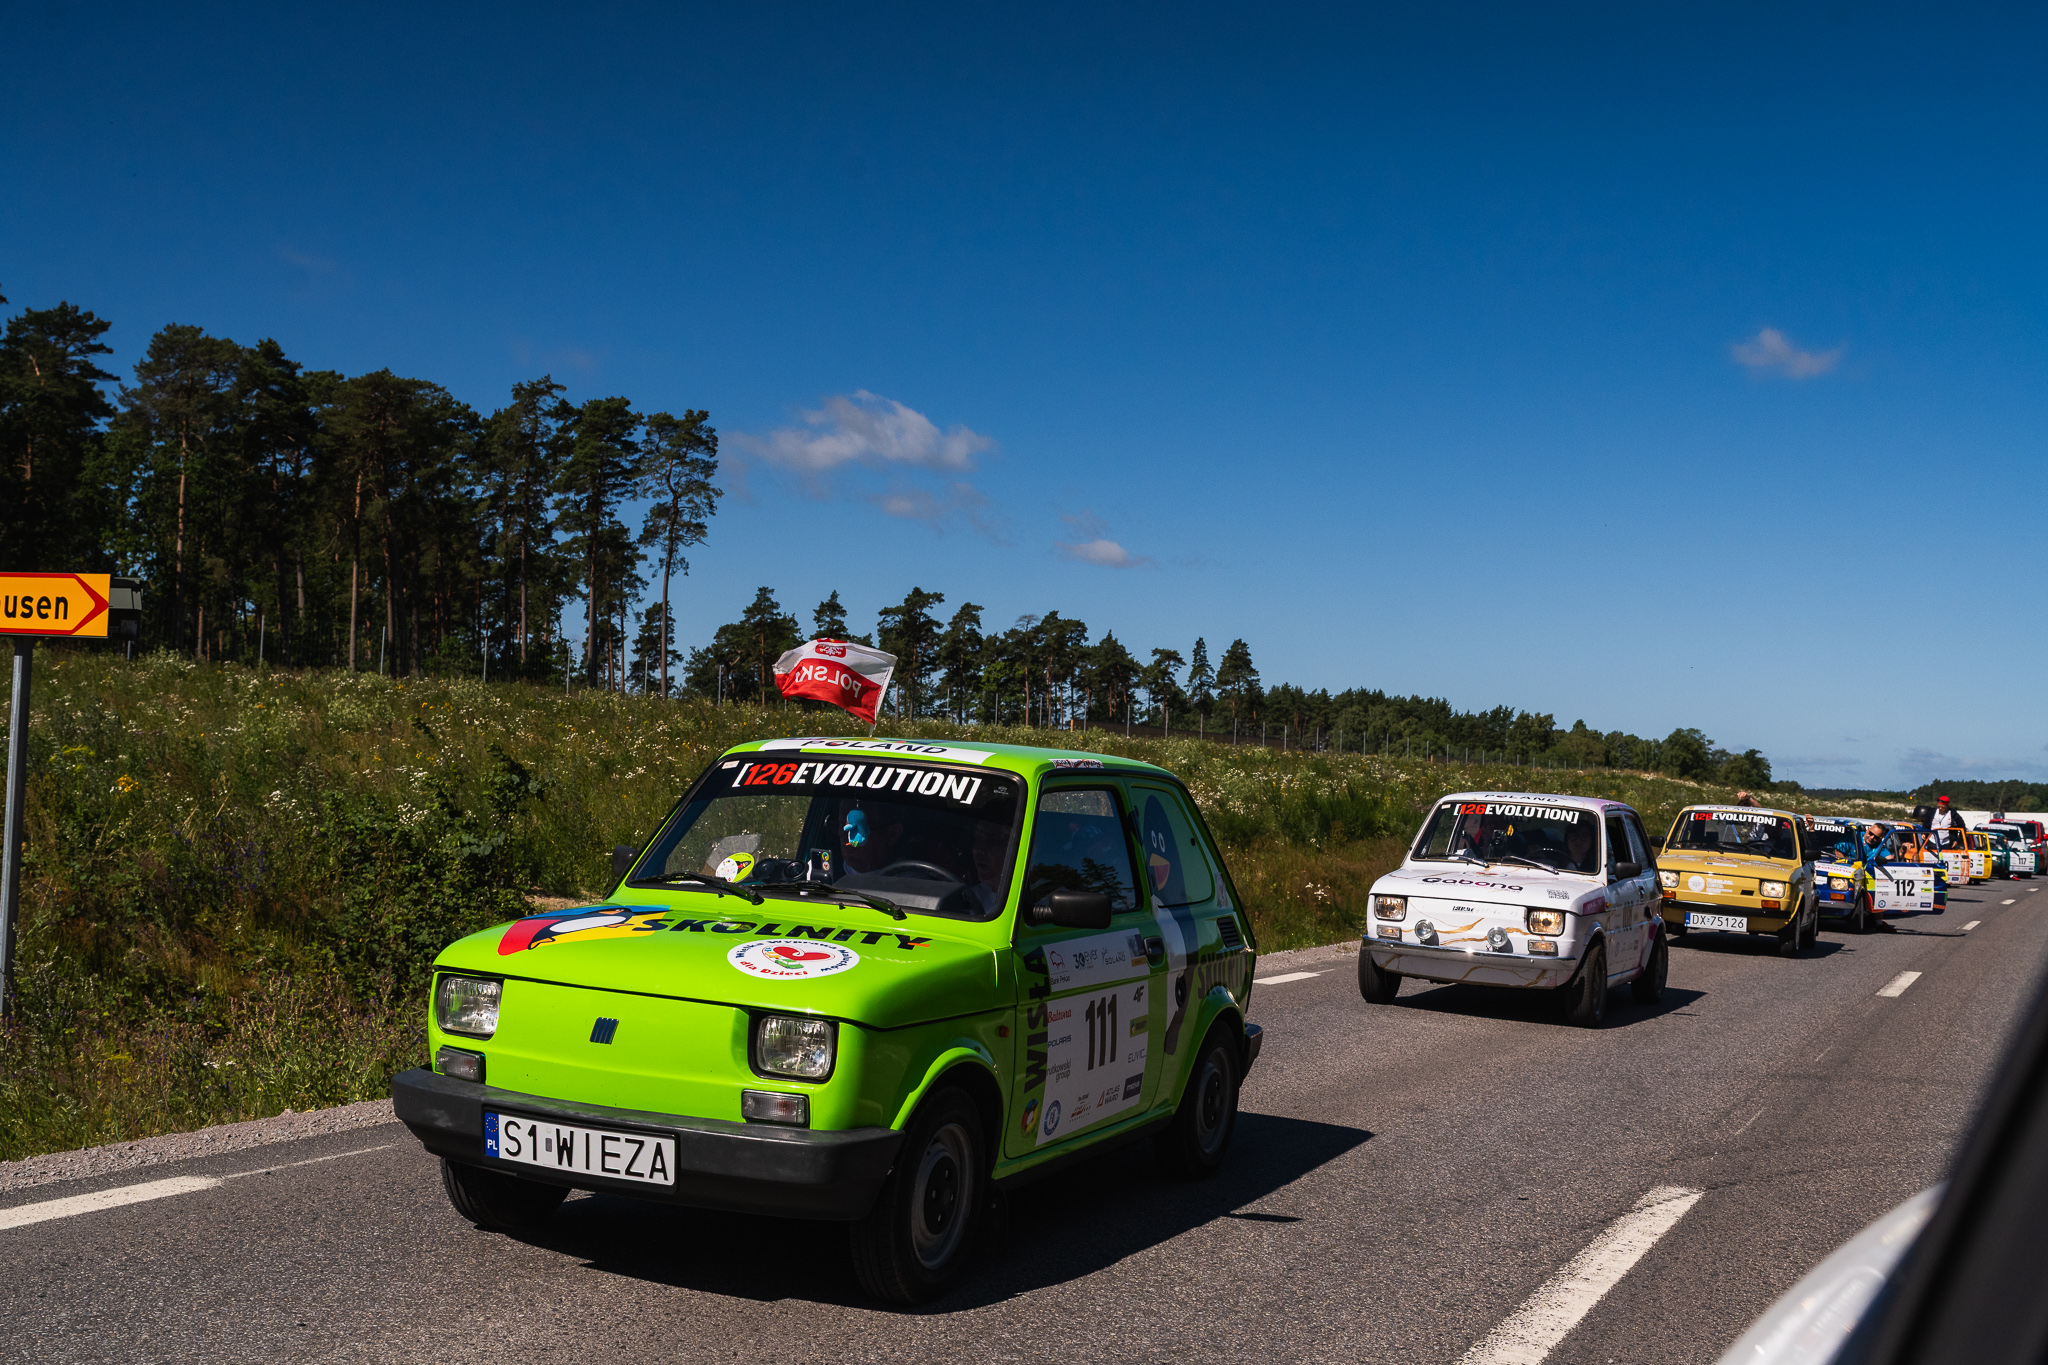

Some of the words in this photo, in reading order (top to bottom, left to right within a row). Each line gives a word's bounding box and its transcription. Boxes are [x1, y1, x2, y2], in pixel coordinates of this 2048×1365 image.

[0, 595, 68, 620] usen
[801, 740, 947, 754] POLAND
[1485, 793, 1558, 802] POLAND
[1894, 880, 1915, 896] 112
[1692, 914, 1706, 926] DX
[1710, 915, 1744, 929] 75126
[632, 918, 934, 951] SKOLNITY
[740, 960, 757, 971] dla
[760, 968, 808, 976] Dzieci
[1048, 1008, 1071, 1023] Baltona
[1085, 994, 1117, 1071] 111
[1048, 1034, 1071, 1048] POLARIS
[1047, 1059, 1071, 1076] rutkowski
[1055, 1070, 1070, 1083] group
[487, 1139, 497, 1151] PL
[504, 1120, 537, 1161] S1
[556, 1128, 668, 1181] WIEZA
